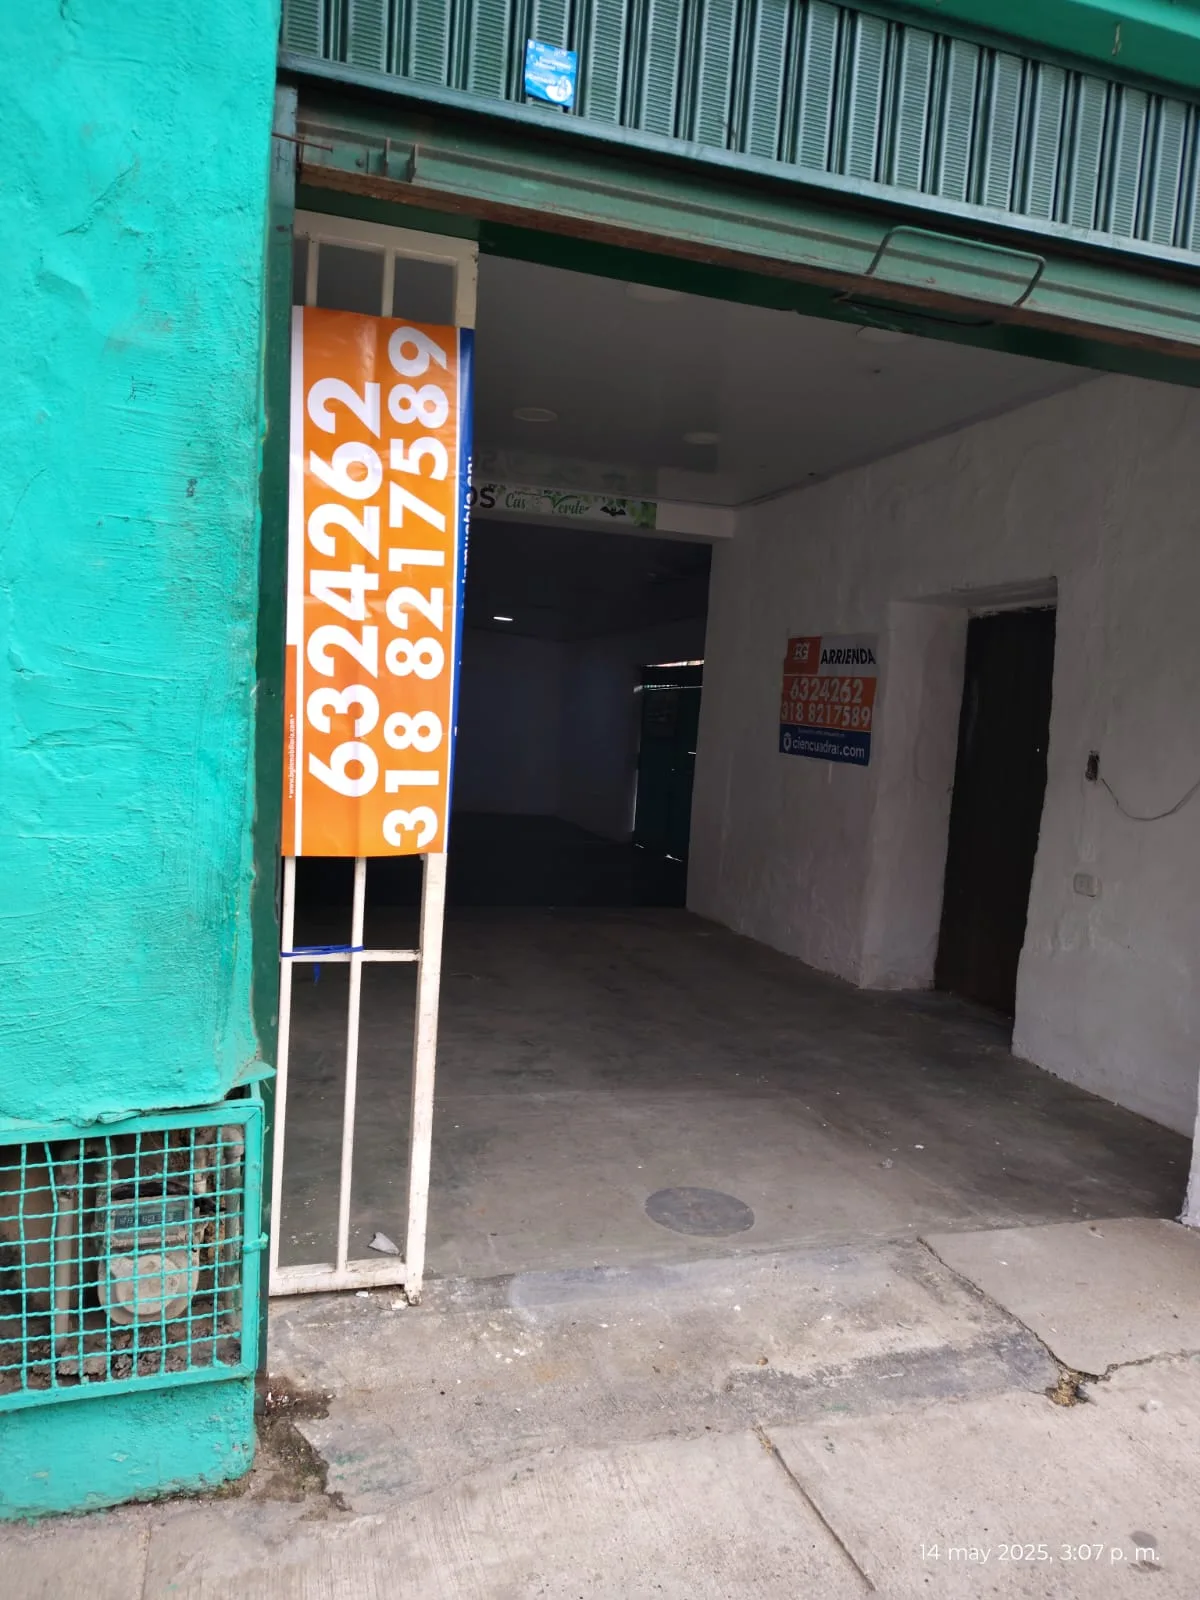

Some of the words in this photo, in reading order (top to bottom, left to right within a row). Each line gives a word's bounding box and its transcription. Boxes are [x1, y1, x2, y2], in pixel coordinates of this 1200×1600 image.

[384, 326, 449, 680] 8217589
[307, 377, 383, 797] 6324262
[790, 677, 864, 704] 6324262
[820, 648, 876, 665] ARRIENDA
[781, 700, 804, 721] 318
[808, 703, 871, 728] 8217589
[382, 711, 443, 848] 318
